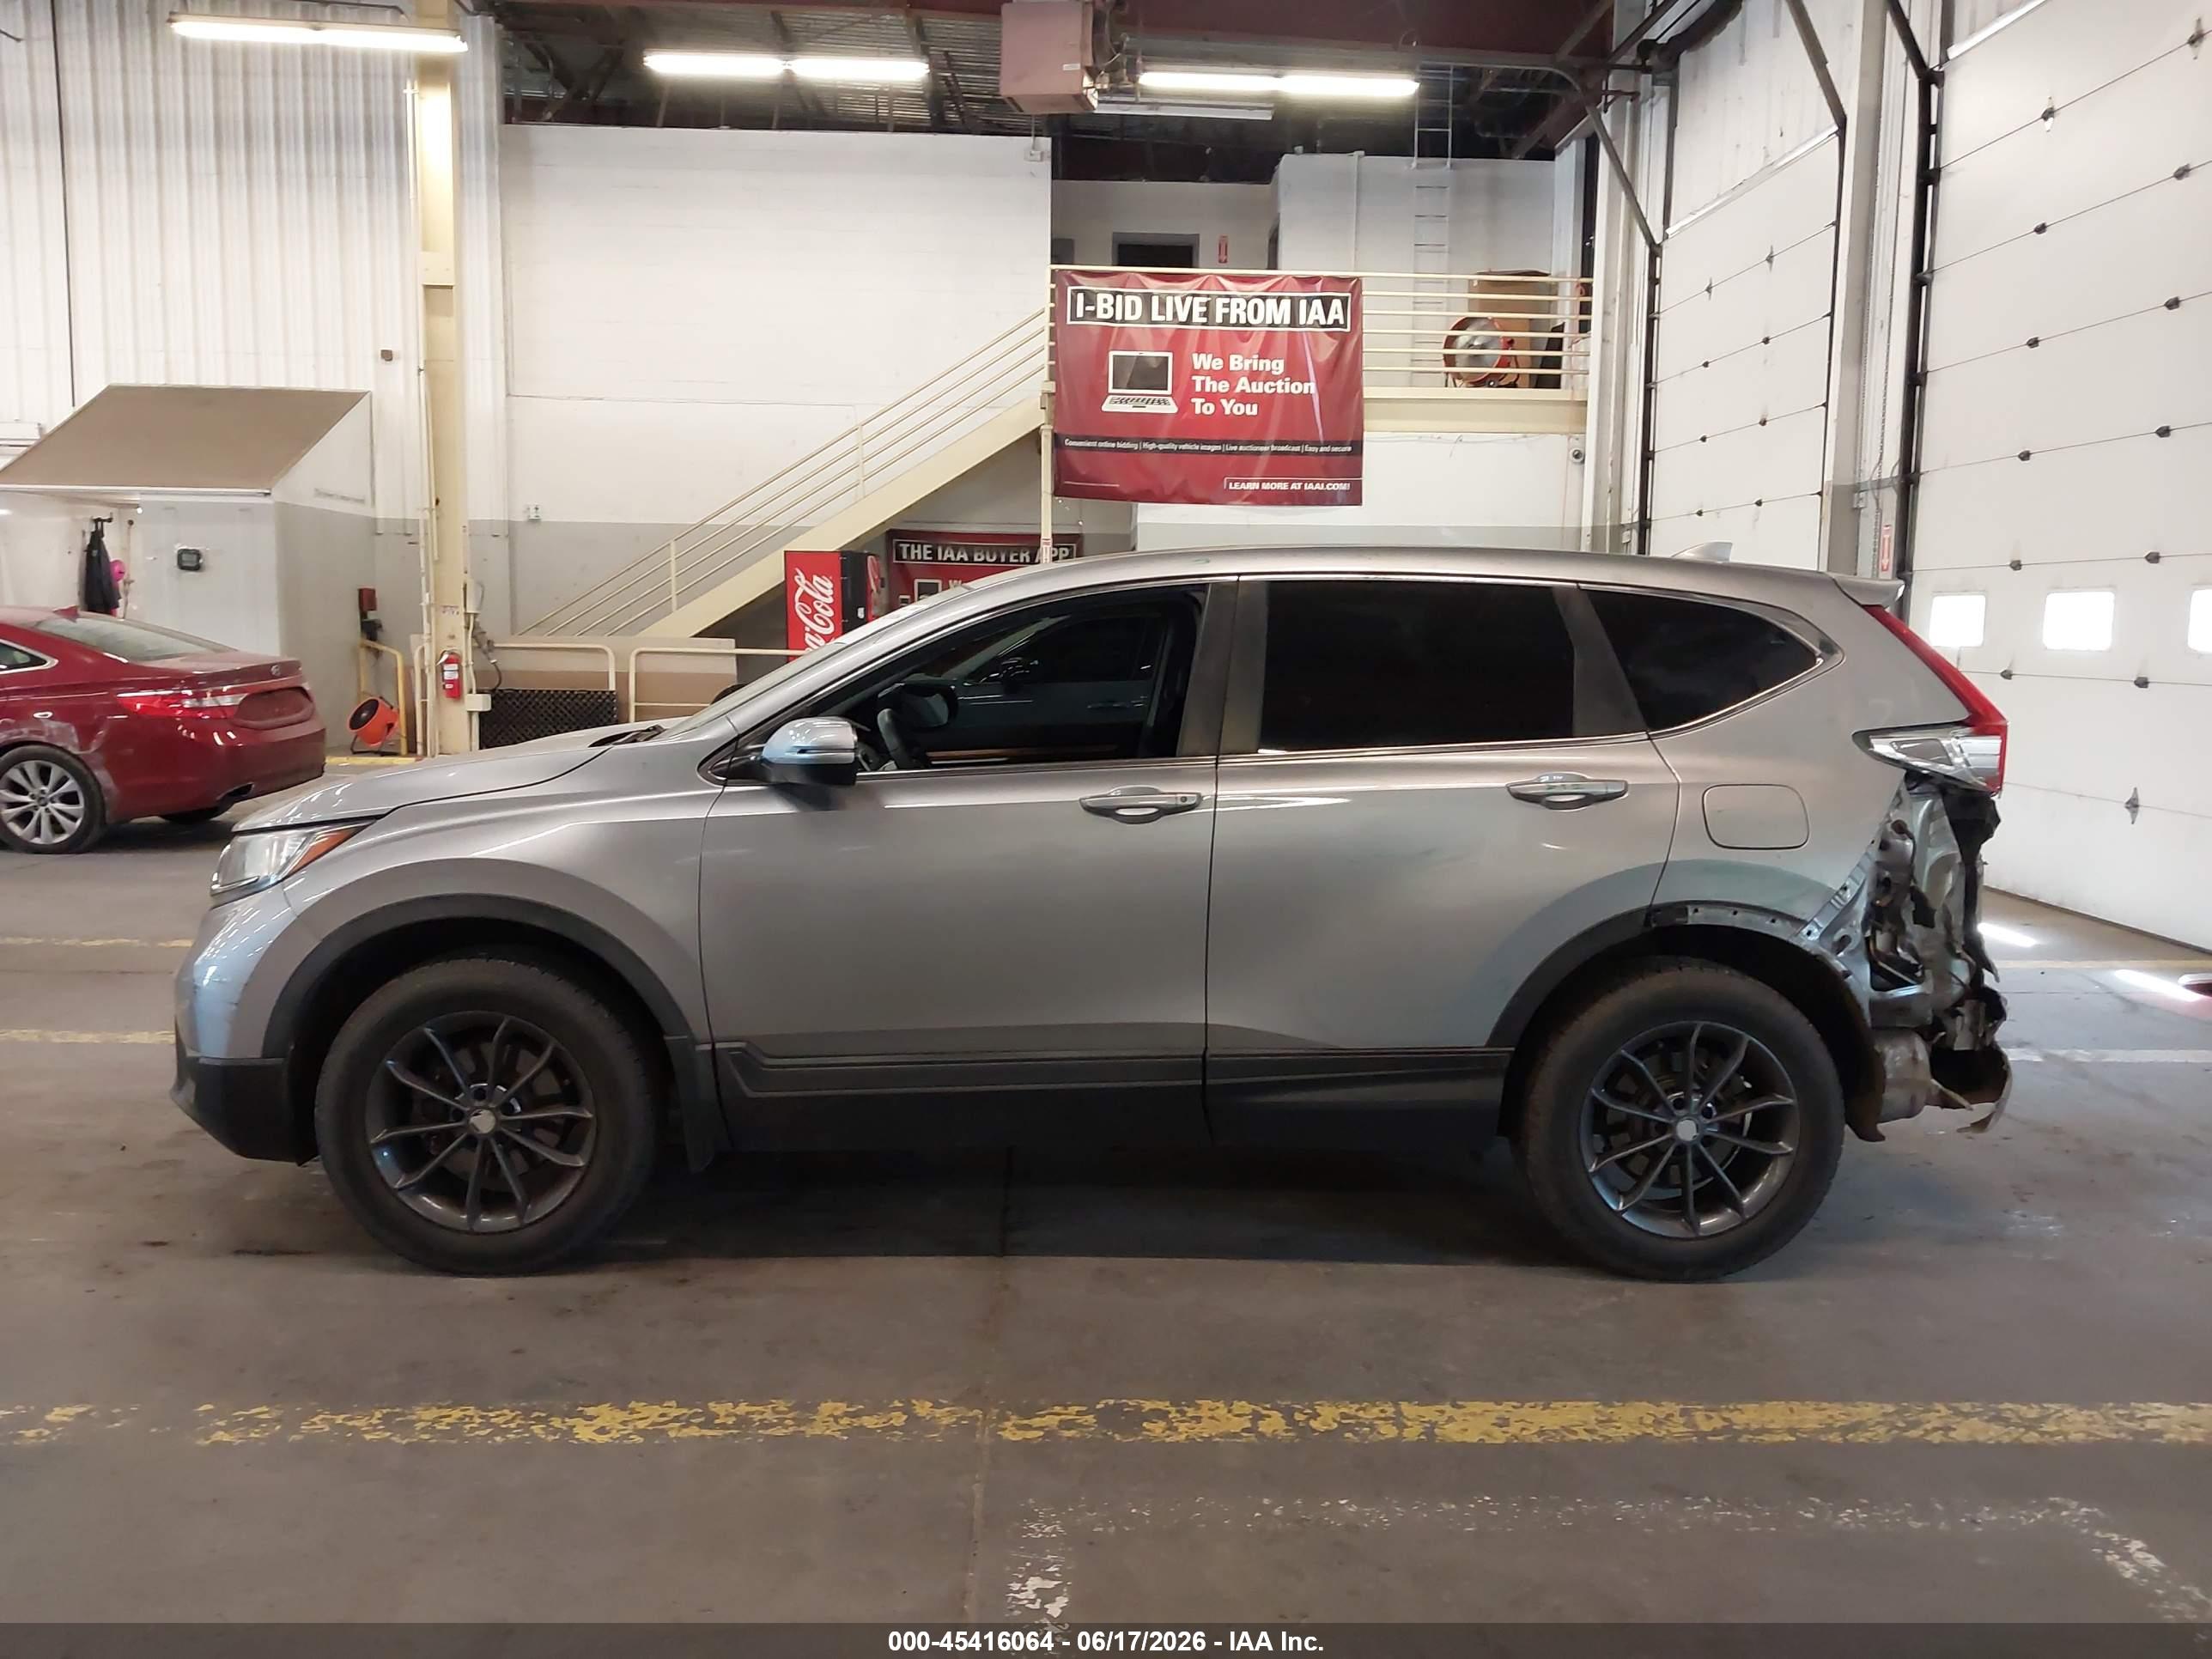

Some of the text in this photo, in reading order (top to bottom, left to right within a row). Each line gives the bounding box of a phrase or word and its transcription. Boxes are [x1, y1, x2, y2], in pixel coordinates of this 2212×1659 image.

[1076, 292, 1345, 325] I-BID LIVE FROM IAA
[1191, 353, 1285, 375] We Bring
[1192, 375, 1316, 395] The Auction
[1191, 398, 1258, 416] To You
[1064, 438, 1097, 447] Convenient
[1098, 440, 1116, 448] online
[1117, 440, 1139, 450] bidding
[1143, 441, 1178, 451] High-quality
[1179, 442, 1200, 451] vehicle
[1200, 443, 1222, 453] images
[1271, 444, 1301, 453] broadcast
[1304, 444, 1319, 453] Easy
[1330, 445, 1352, 453] secure
[1229, 482, 1260, 490] LEARN
[1261, 482, 1289, 490] MORE
[899, 543, 933, 561] THE
[938, 545, 969, 562] IAA
[973, 548, 1030, 563] BUYER
